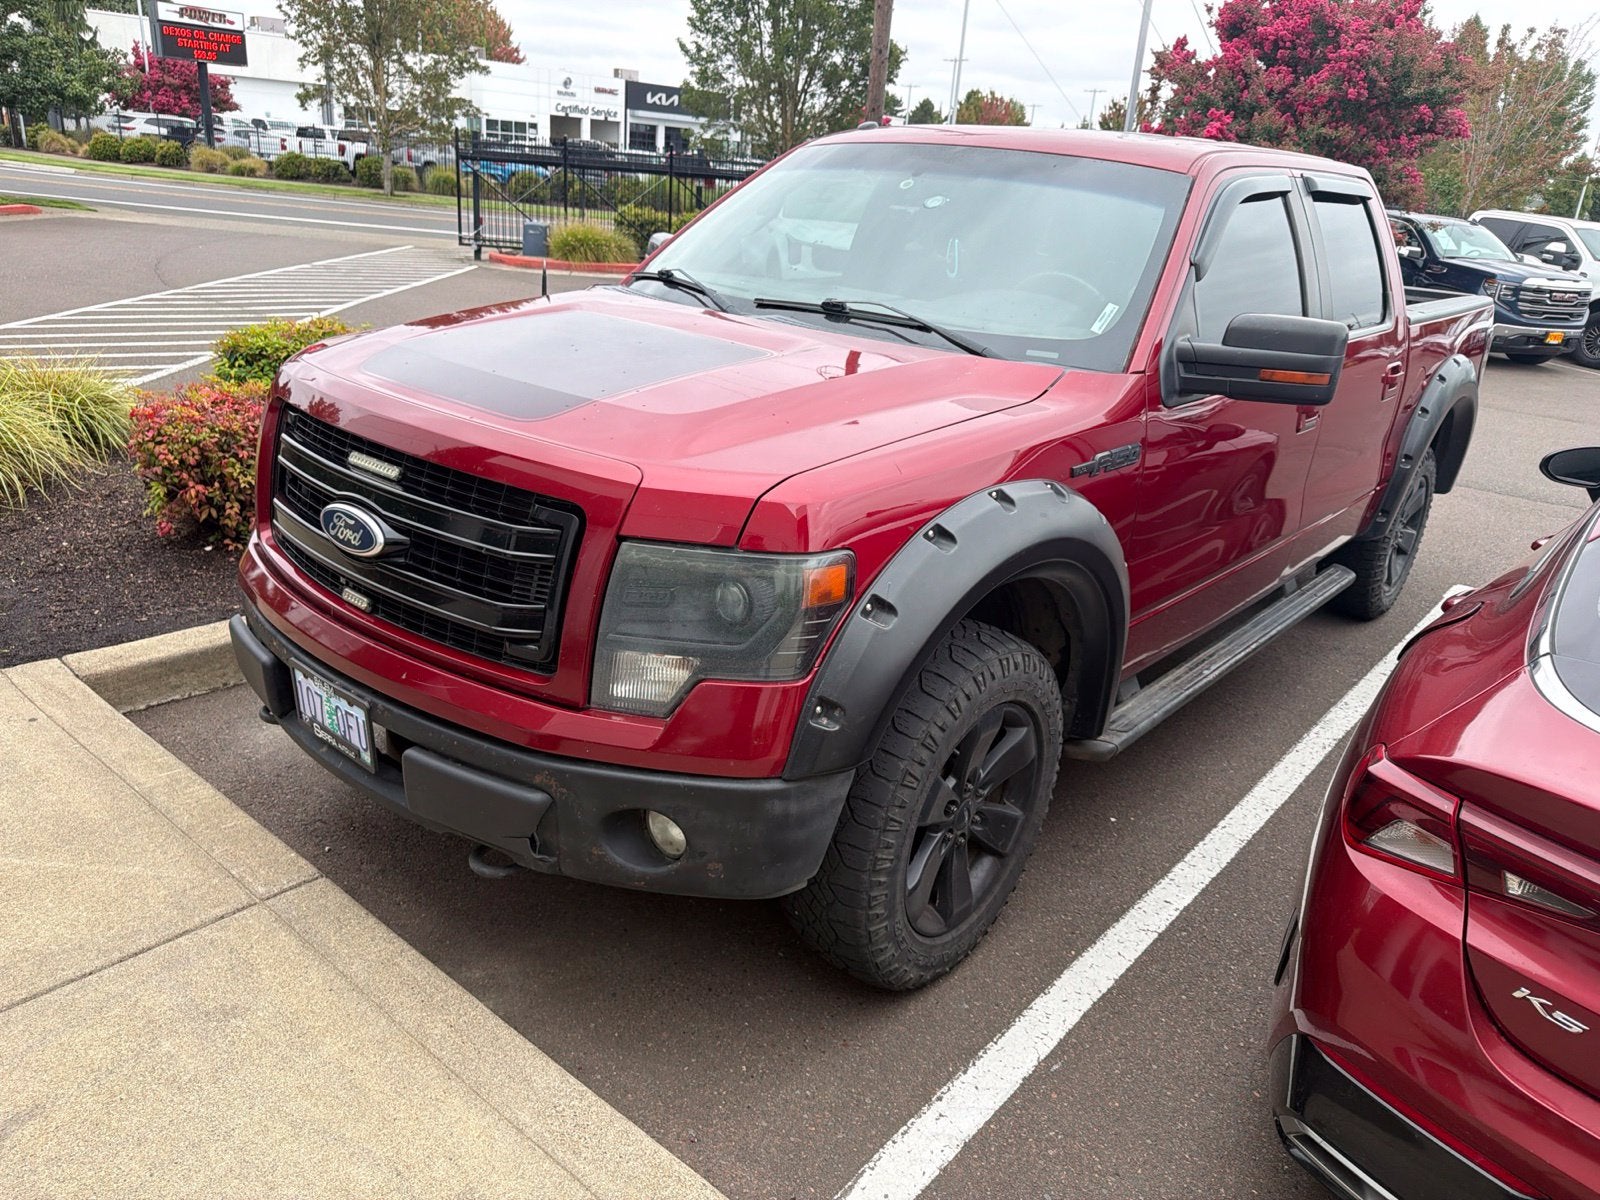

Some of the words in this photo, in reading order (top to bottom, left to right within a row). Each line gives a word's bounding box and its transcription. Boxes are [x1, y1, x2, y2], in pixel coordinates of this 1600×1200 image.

[179, 7, 226, 24] POWER
[162, 26, 192, 37] DEXOS
[193, 30, 206, 39] OIL
[208, 32, 242, 44] CHANGE
[177, 38, 218, 50] STARTING
[219, 44, 231, 52] AT
[646, 91, 679, 107] KIA
[555, 102, 590, 116] Certified
[591, 106, 618, 118] Service
[328, 512, 364, 547] Ford
[1511, 986, 1590, 1033] K5
